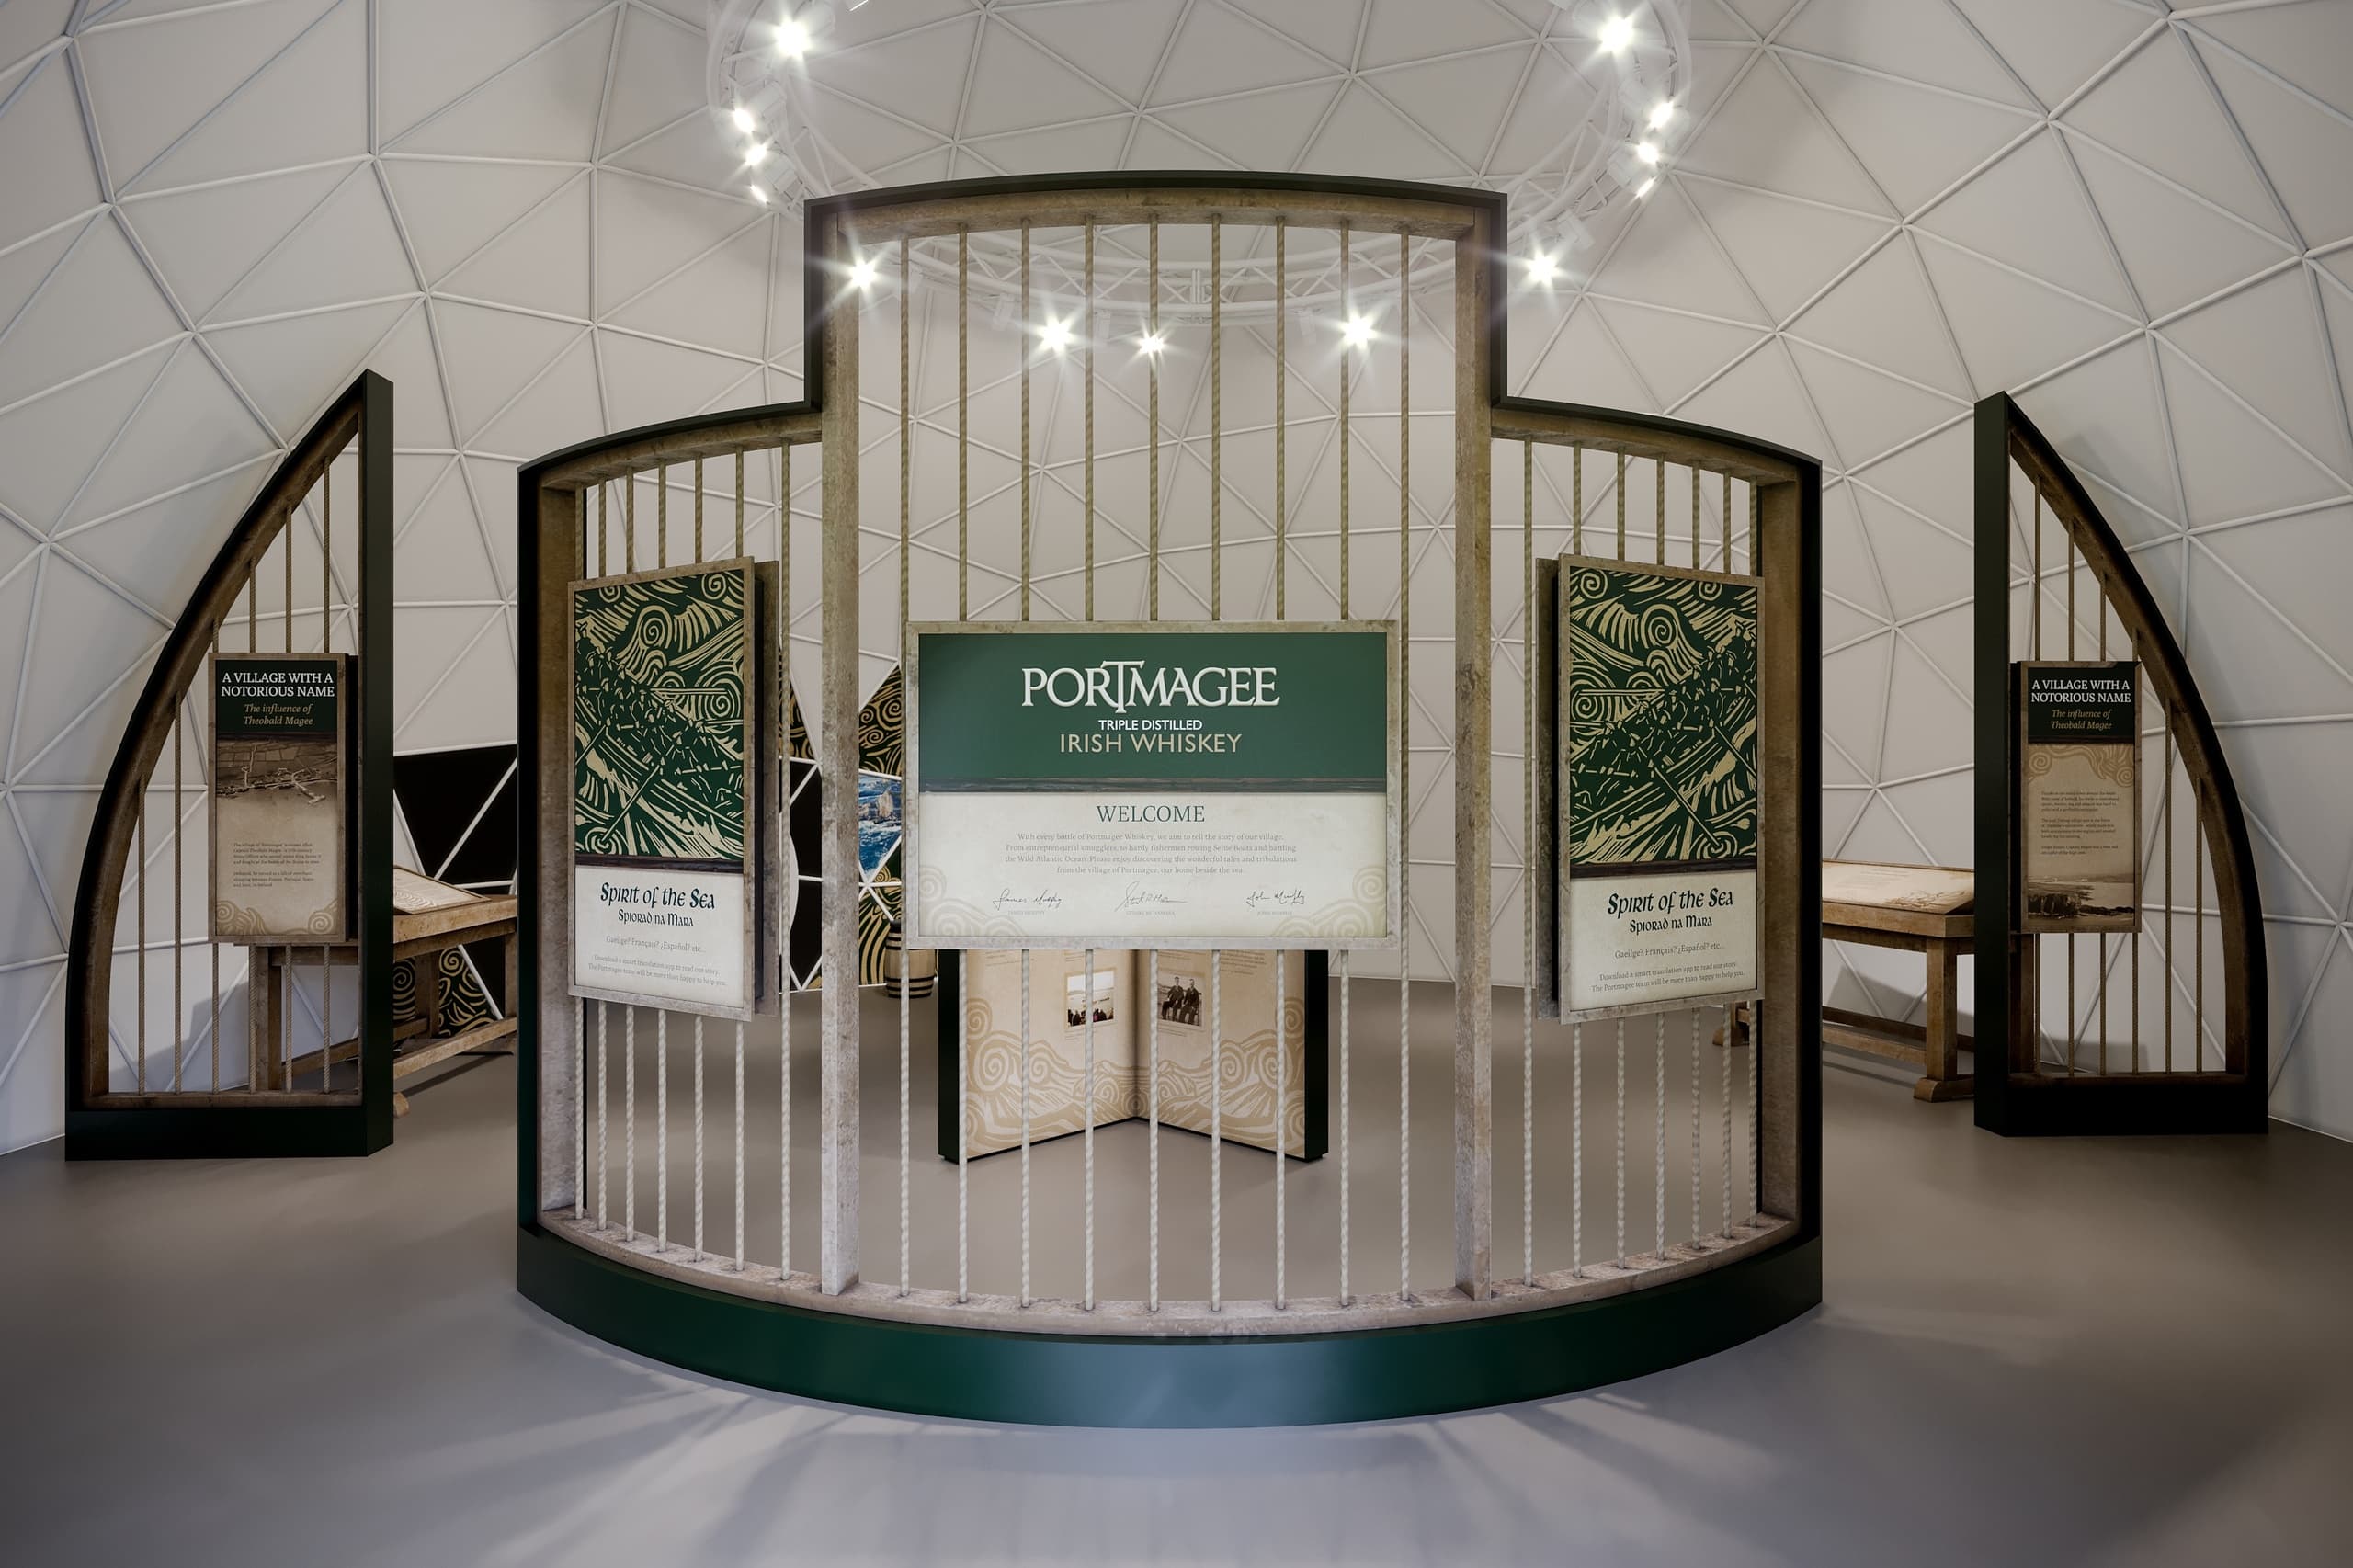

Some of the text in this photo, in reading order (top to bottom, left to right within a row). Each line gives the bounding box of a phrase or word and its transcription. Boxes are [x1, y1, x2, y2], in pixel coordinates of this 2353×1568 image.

[222, 673, 333, 684] A VILLAGE WITH A
[1021, 660, 1280, 713] PORTMAGEE
[2032, 680, 2130, 690] A VILLAGE WITH A
[222, 686, 335, 697] NOTORIOUS NAME
[2031, 692, 2131, 703] NOTORIOUS NAME
[244, 703, 313, 715] The influence of
[2052, 709, 2111, 721] The influence of
[243, 715, 313, 727] Theobald Magee
[1098, 720, 1202, 732] TRIPLE DISTILLED
[2051, 720, 2112, 732] Theobald Magee
[1060, 733, 1242, 753] IRISH WHISKEY
[1097, 805, 1205, 823] WELCOME
[600, 882, 715, 909] Spirit of the Sea
[1608, 888, 1733, 919] Spirit of the Sea
[618, 909, 694, 926] Spiorad na Mara
[1629, 915, 1712, 935] Spiorad na Mara
[1614, 948, 1643, 959] Gaeilge?
[1645, 946, 1677, 957] Français?
[1678, 943, 1709, 954] ¿Español?
